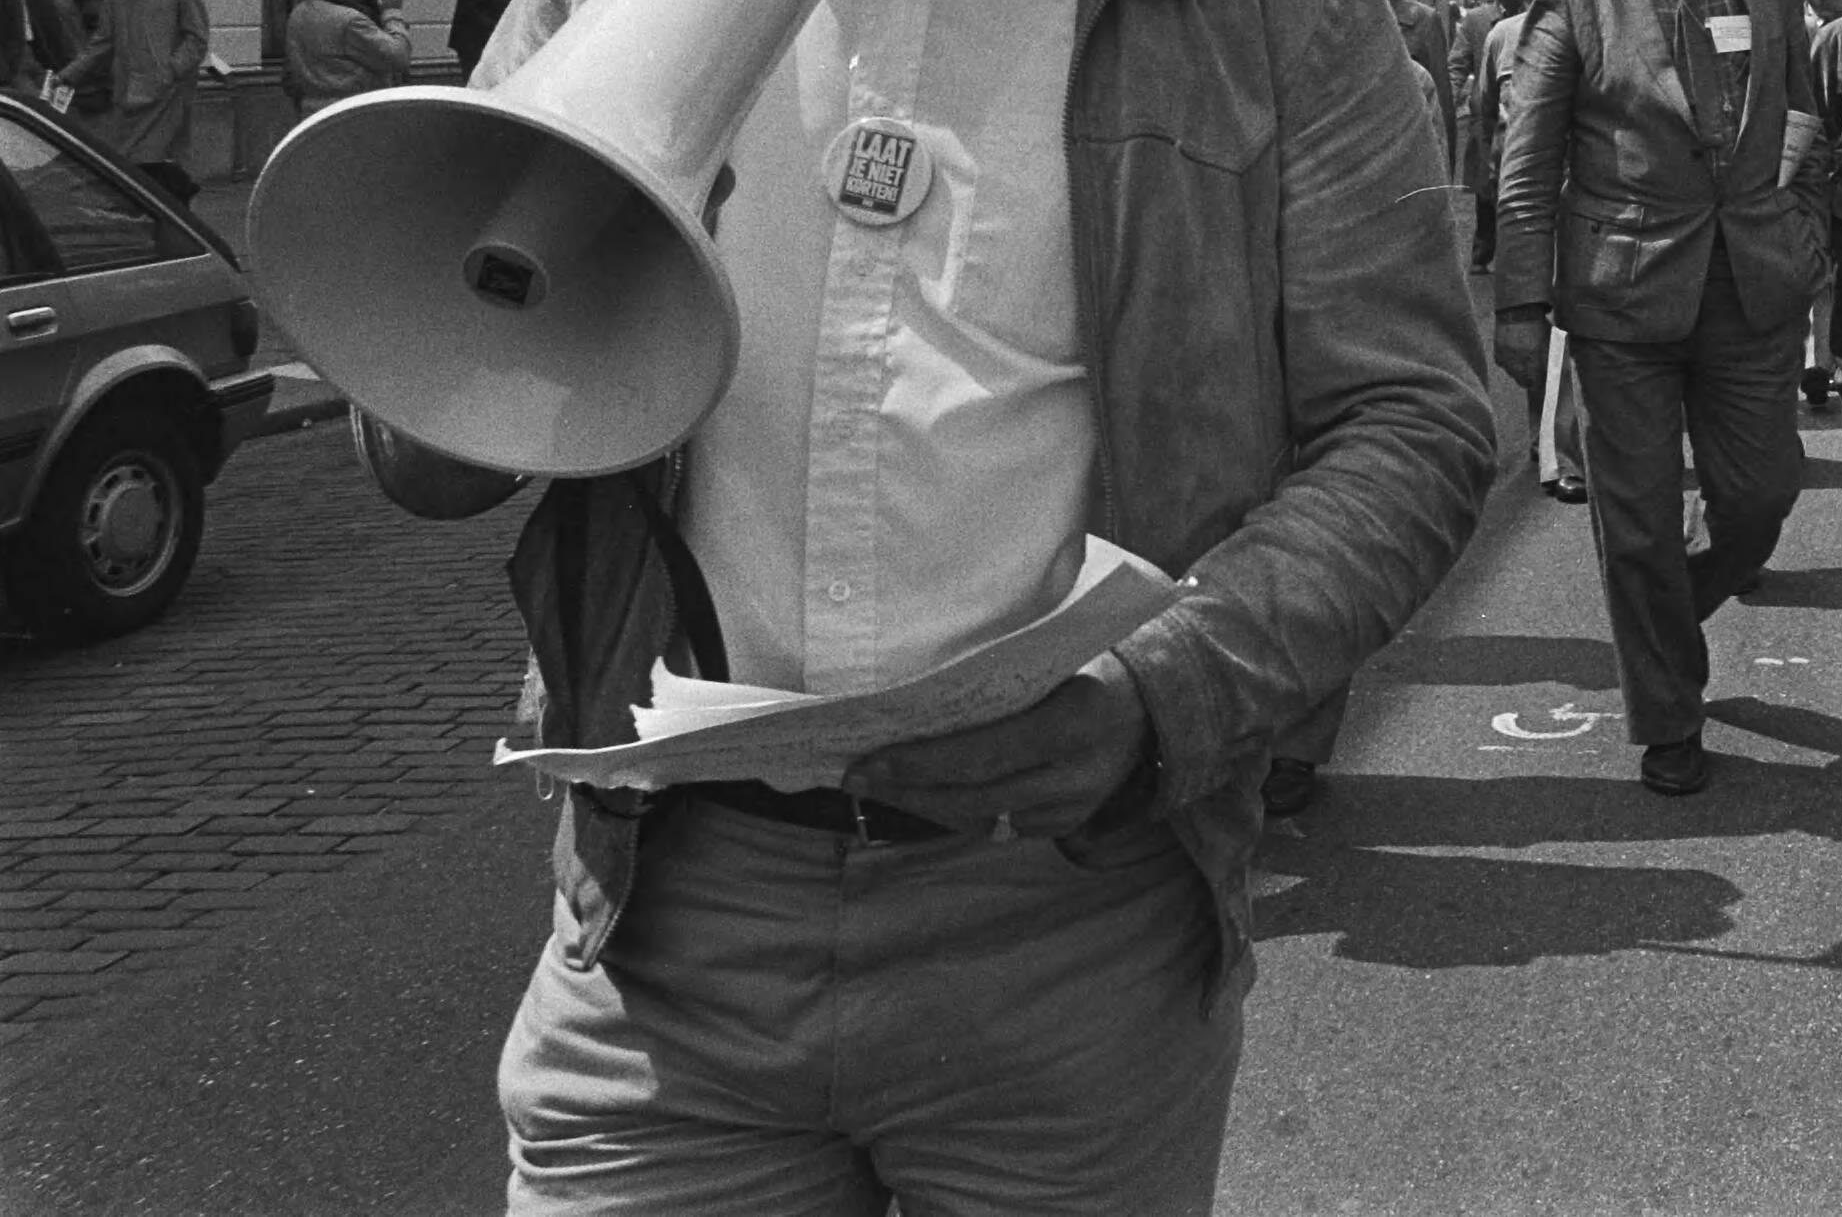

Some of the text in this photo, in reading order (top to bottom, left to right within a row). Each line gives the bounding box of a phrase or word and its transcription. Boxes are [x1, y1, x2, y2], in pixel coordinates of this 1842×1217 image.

[855, 130, 913, 168] LAAT
[849, 157, 905, 187] JE NIET
